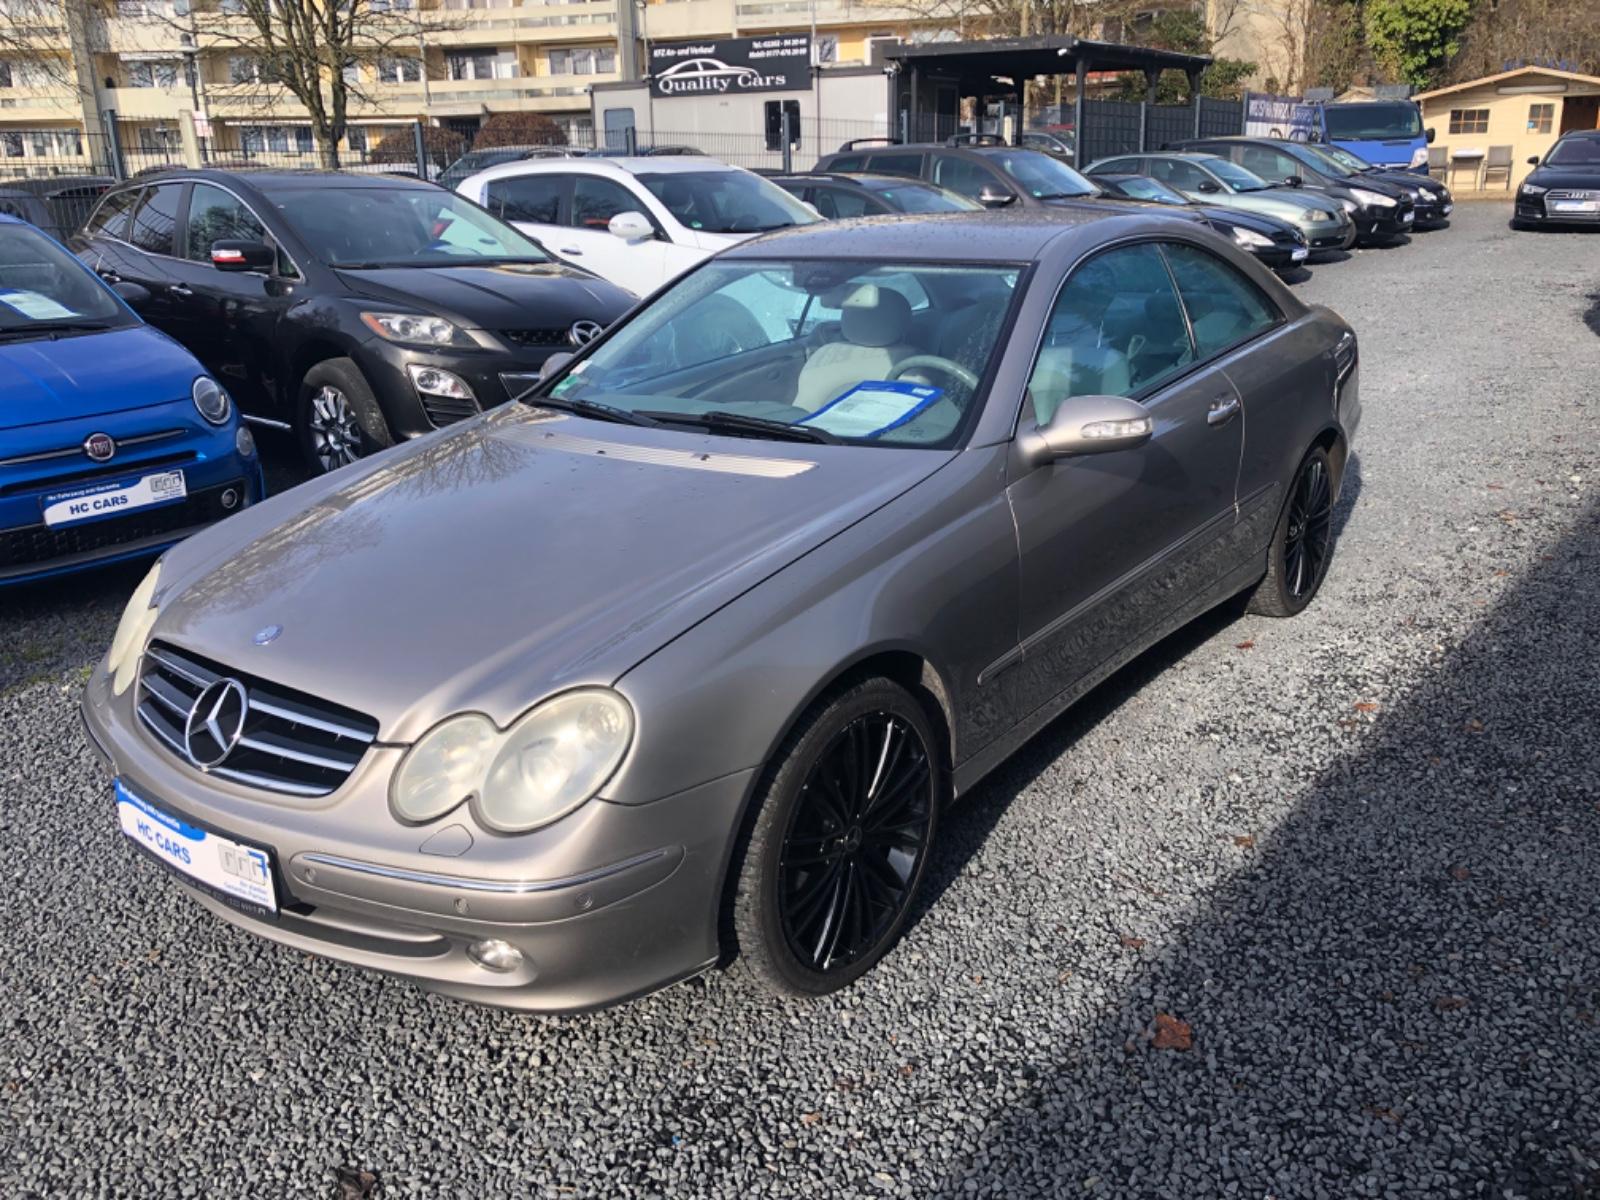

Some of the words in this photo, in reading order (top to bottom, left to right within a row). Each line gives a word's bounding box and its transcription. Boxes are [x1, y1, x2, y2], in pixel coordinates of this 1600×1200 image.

[658, 76, 731, 94] Quality
[737, 73, 786, 88] Cars
[69, 503, 90, 515] HC
[92, 494, 128, 510] CARS
[136, 818, 153, 842] HC
[155, 832, 192, 865] CARS
